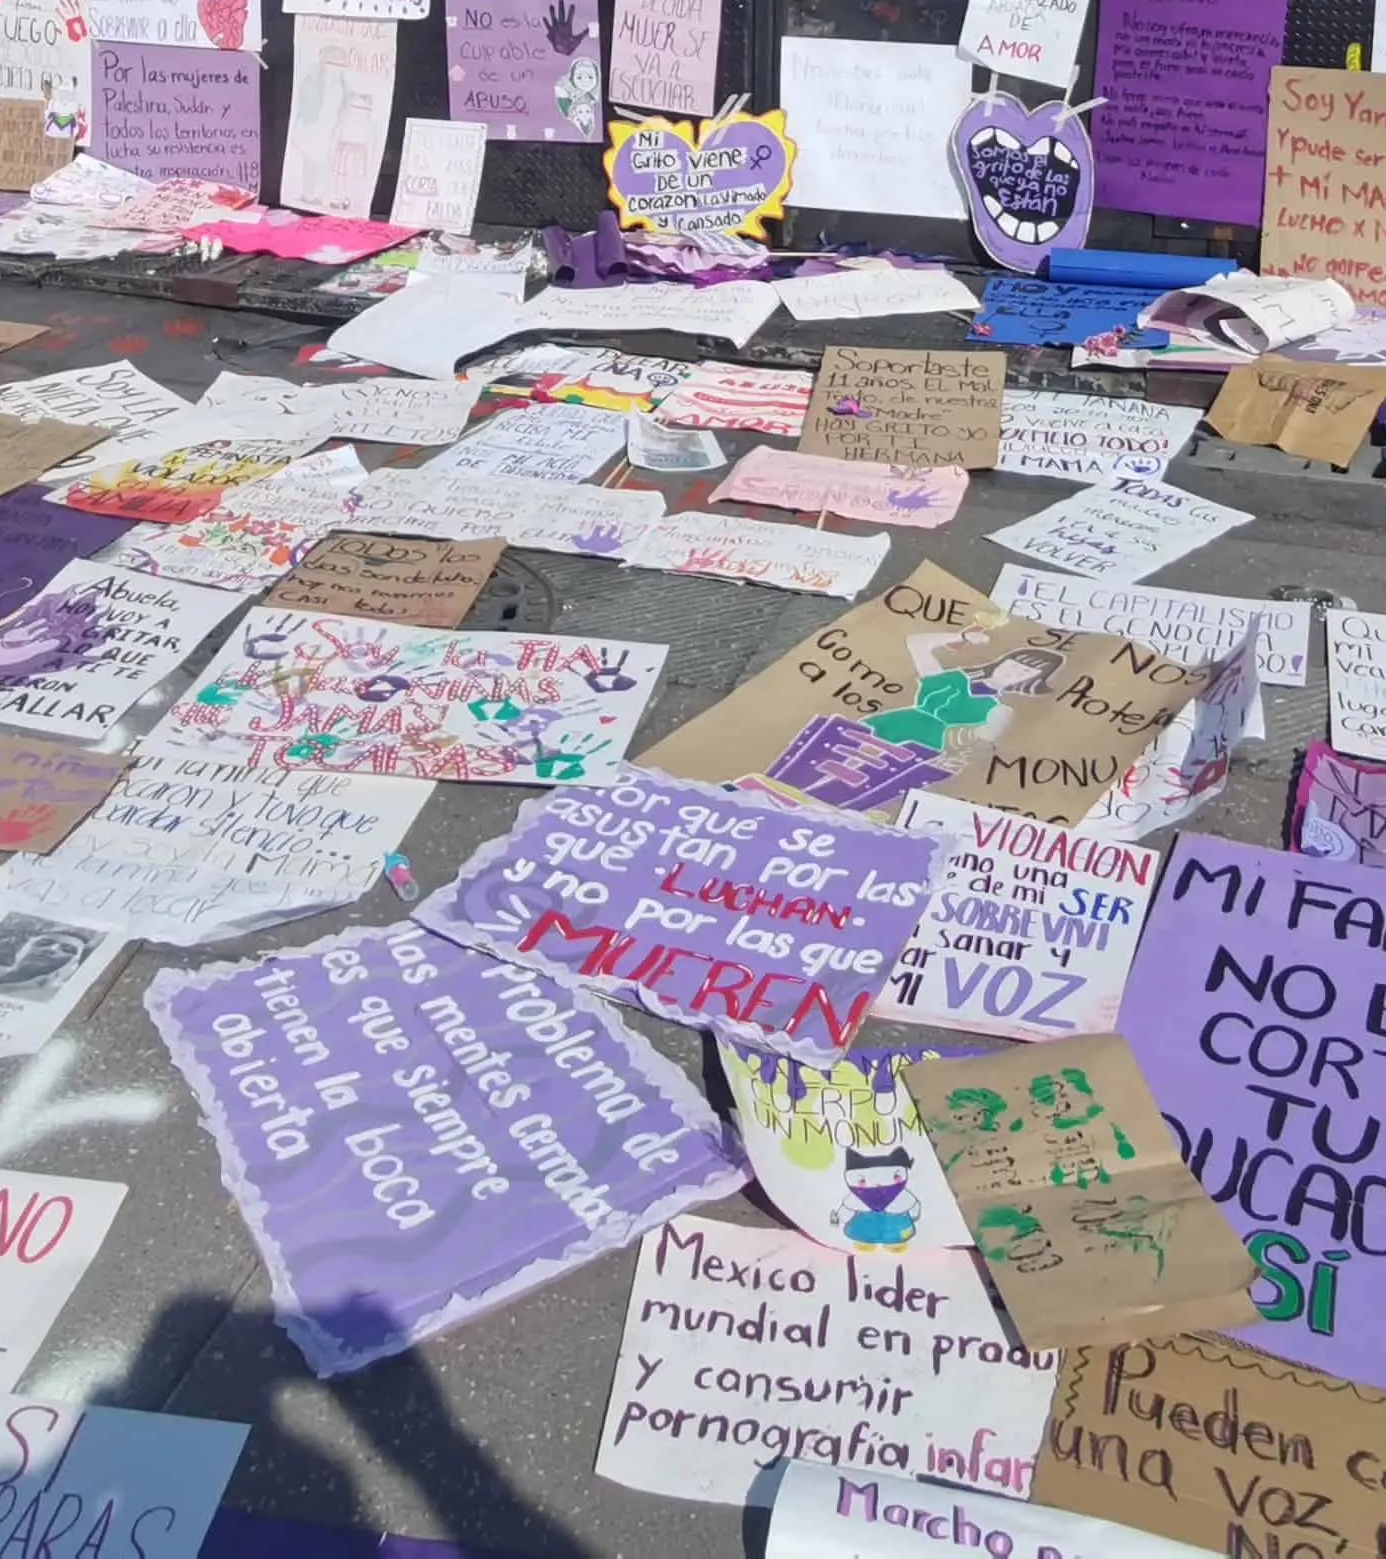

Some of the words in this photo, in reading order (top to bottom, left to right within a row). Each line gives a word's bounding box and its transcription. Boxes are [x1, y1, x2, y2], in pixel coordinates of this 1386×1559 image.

[465, 9, 492, 28] NO
[619, 14, 677, 51] MUJER
[1009, 15, 1032, 31] DE
[977, 35, 1042, 62] AMOR
[99, 50, 133, 83] Por
[141, 55, 166, 83] las
[171, 69, 229, 88] mujeres
[235, 70, 249, 84] de
[511, 69, 534, 82] un
[465, 92, 528, 111] ABUSO
[1283, 78, 1333, 121] Soy
[104, 115, 144, 139] todos
[149, 119, 169, 140] los
[633, 152, 676, 169] Grito
[1292, 134, 1345, 165] pude
[1355, 149, 1385, 167] ser
[689, 173, 713, 187] un
[1277, 207, 1344, 235] LUCHO
[835, 348, 991, 379] Soportaste
[844, 448, 965, 463] HERMANA
[83, 576, 181, 611] Abuela,
[883, 584, 968, 624] QUE
[81, 624, 182, 654] GRITAR,
[101, 648, 155, 666] QUE
[779, 825, 836, 859] se
[760, 853, 847, 896] por
[1014, 864, 1068, 888] una
[969, 875, 1003, 896] de
[1012, 884, 1045, 904] mi
[1059, 888, 1134, 925] SER
[544, 868, 610, 907] no
[633, 896, 717, 942] por
[724, 914, 794, 964] las
[799, 934, 883, 976] que
[518, 909, 871, 1048] MUEREN
[944, 957, 1088, 1029] VOZ
[1205, 945, 1337, 1020] NO
[422, 996, 532, 1110] mentes
[212, 1011, 312, 1160] abierta
[254, 967, 330, 1063] tienen
[314, 1070, 361, 1112] la
[344, 1126, 436, 1232] boca
[393, 1056, 511, 1201] siempre
[1245, 1084, 1382, 1165] TU
[622, 1128, 685, 1173] de
[656, 1222, 817, 1293] Mexico
[641, 1301, 831, 1348] mundial
[858, 1325, 913, 1355] en
[1107, 1339, 1316, 1472] Pueden
[1049, 1418, 1177, 1498] una
